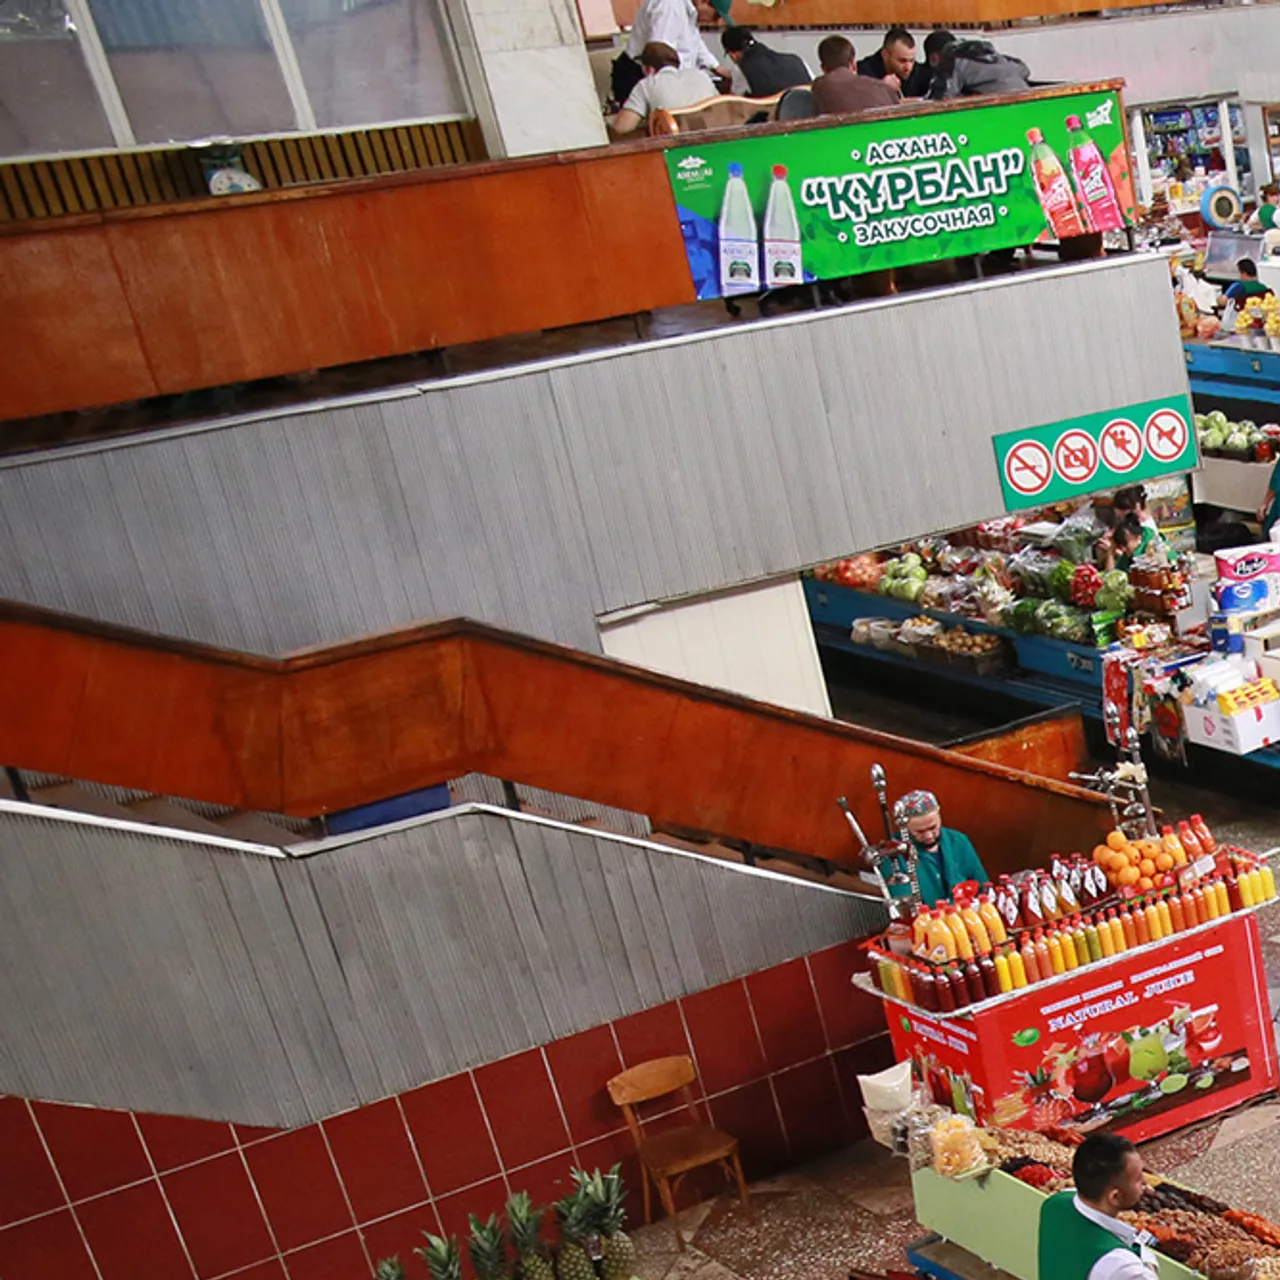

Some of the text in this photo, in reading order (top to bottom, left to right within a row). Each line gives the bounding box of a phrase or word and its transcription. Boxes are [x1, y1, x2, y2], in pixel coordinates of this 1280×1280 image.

[867, 133, 955, 163] АСХАНА
[854, 203, 994, 244] ЗАКУСОЧНАЯ
[1048, 991, 1139, 1032] NATURAL
[1143, 970, 1196, 998] JUICE
